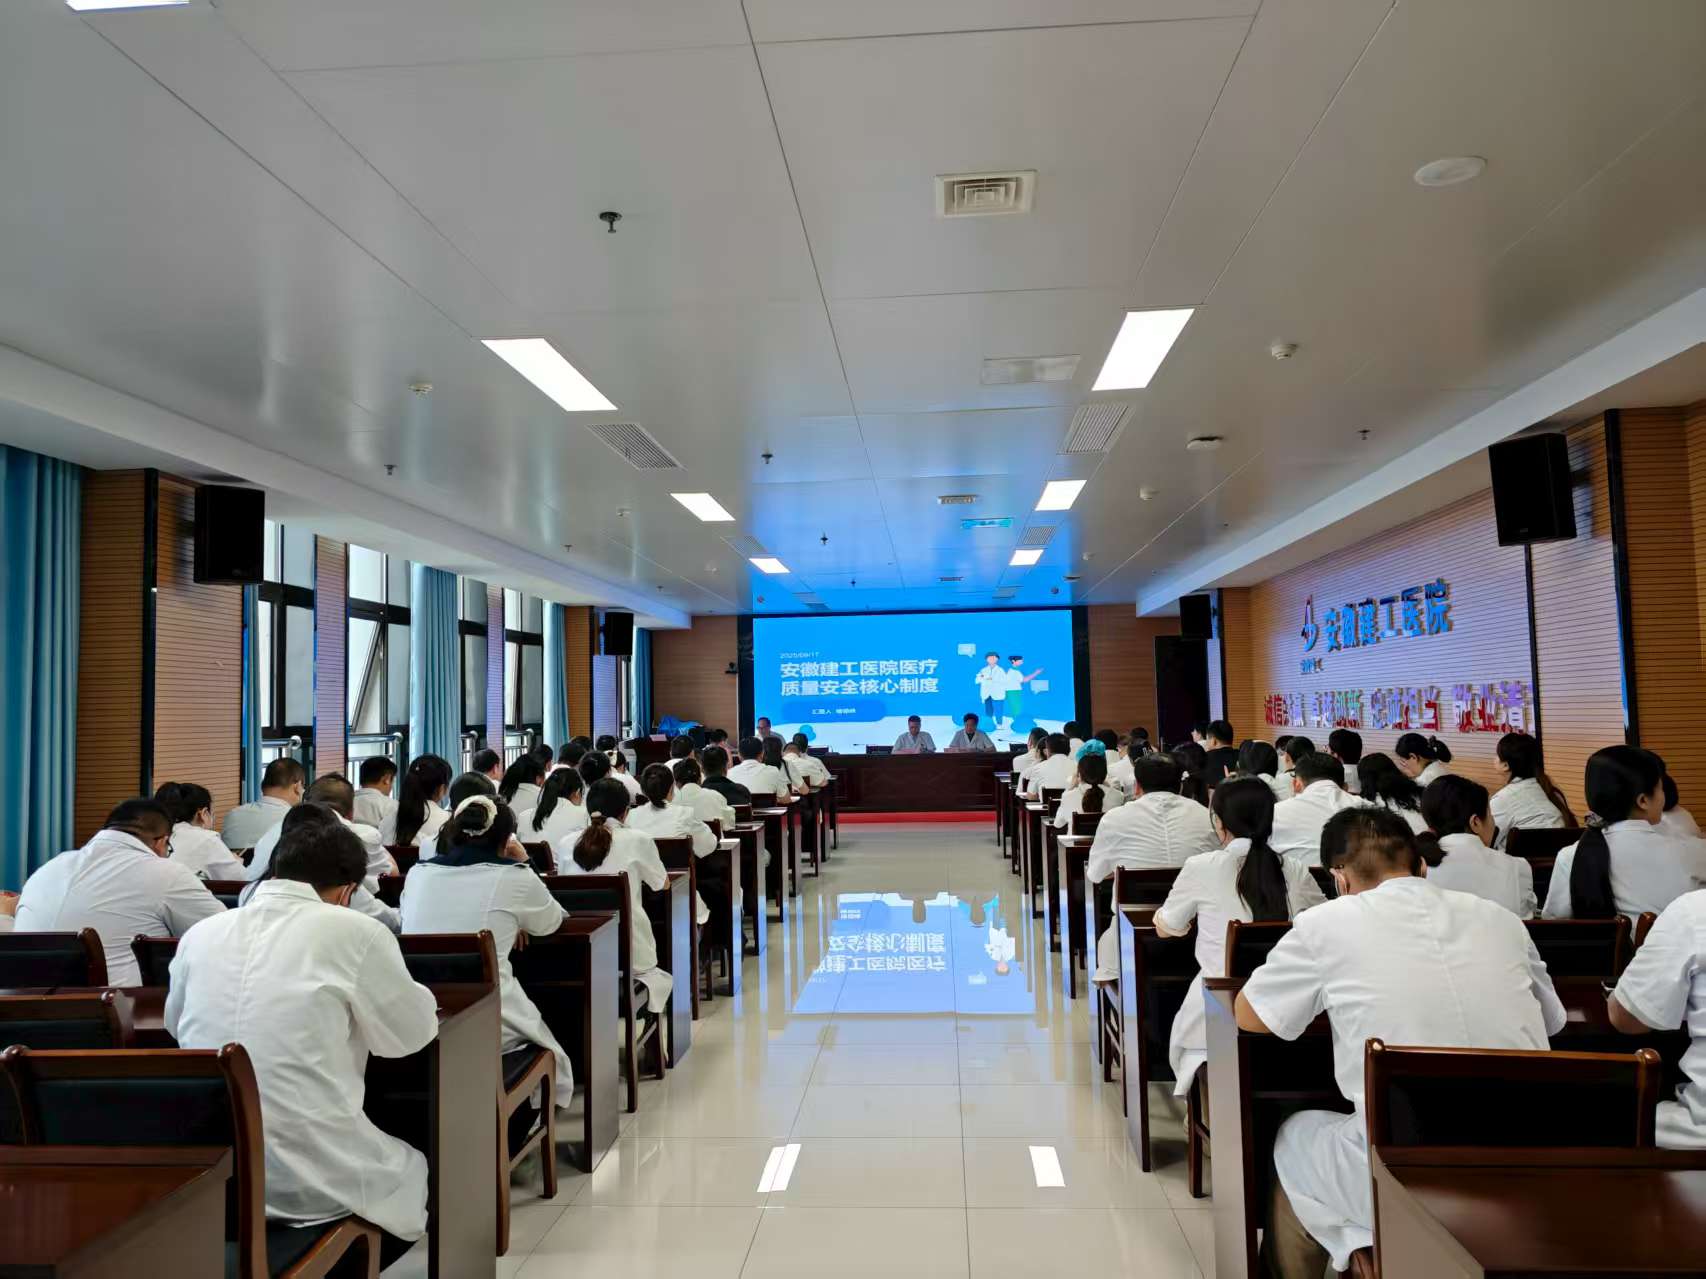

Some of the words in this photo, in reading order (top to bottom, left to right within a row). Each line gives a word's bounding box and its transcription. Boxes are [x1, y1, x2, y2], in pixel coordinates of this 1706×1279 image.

[1323, 577, 1453, 652] 安徽建工医院
[780, 659, 939, 678] 安徽建工医院医疗
[781, 677, 939, 697] 质量安全核心制度
[1451, 680, 1535, 734] 敬业清
